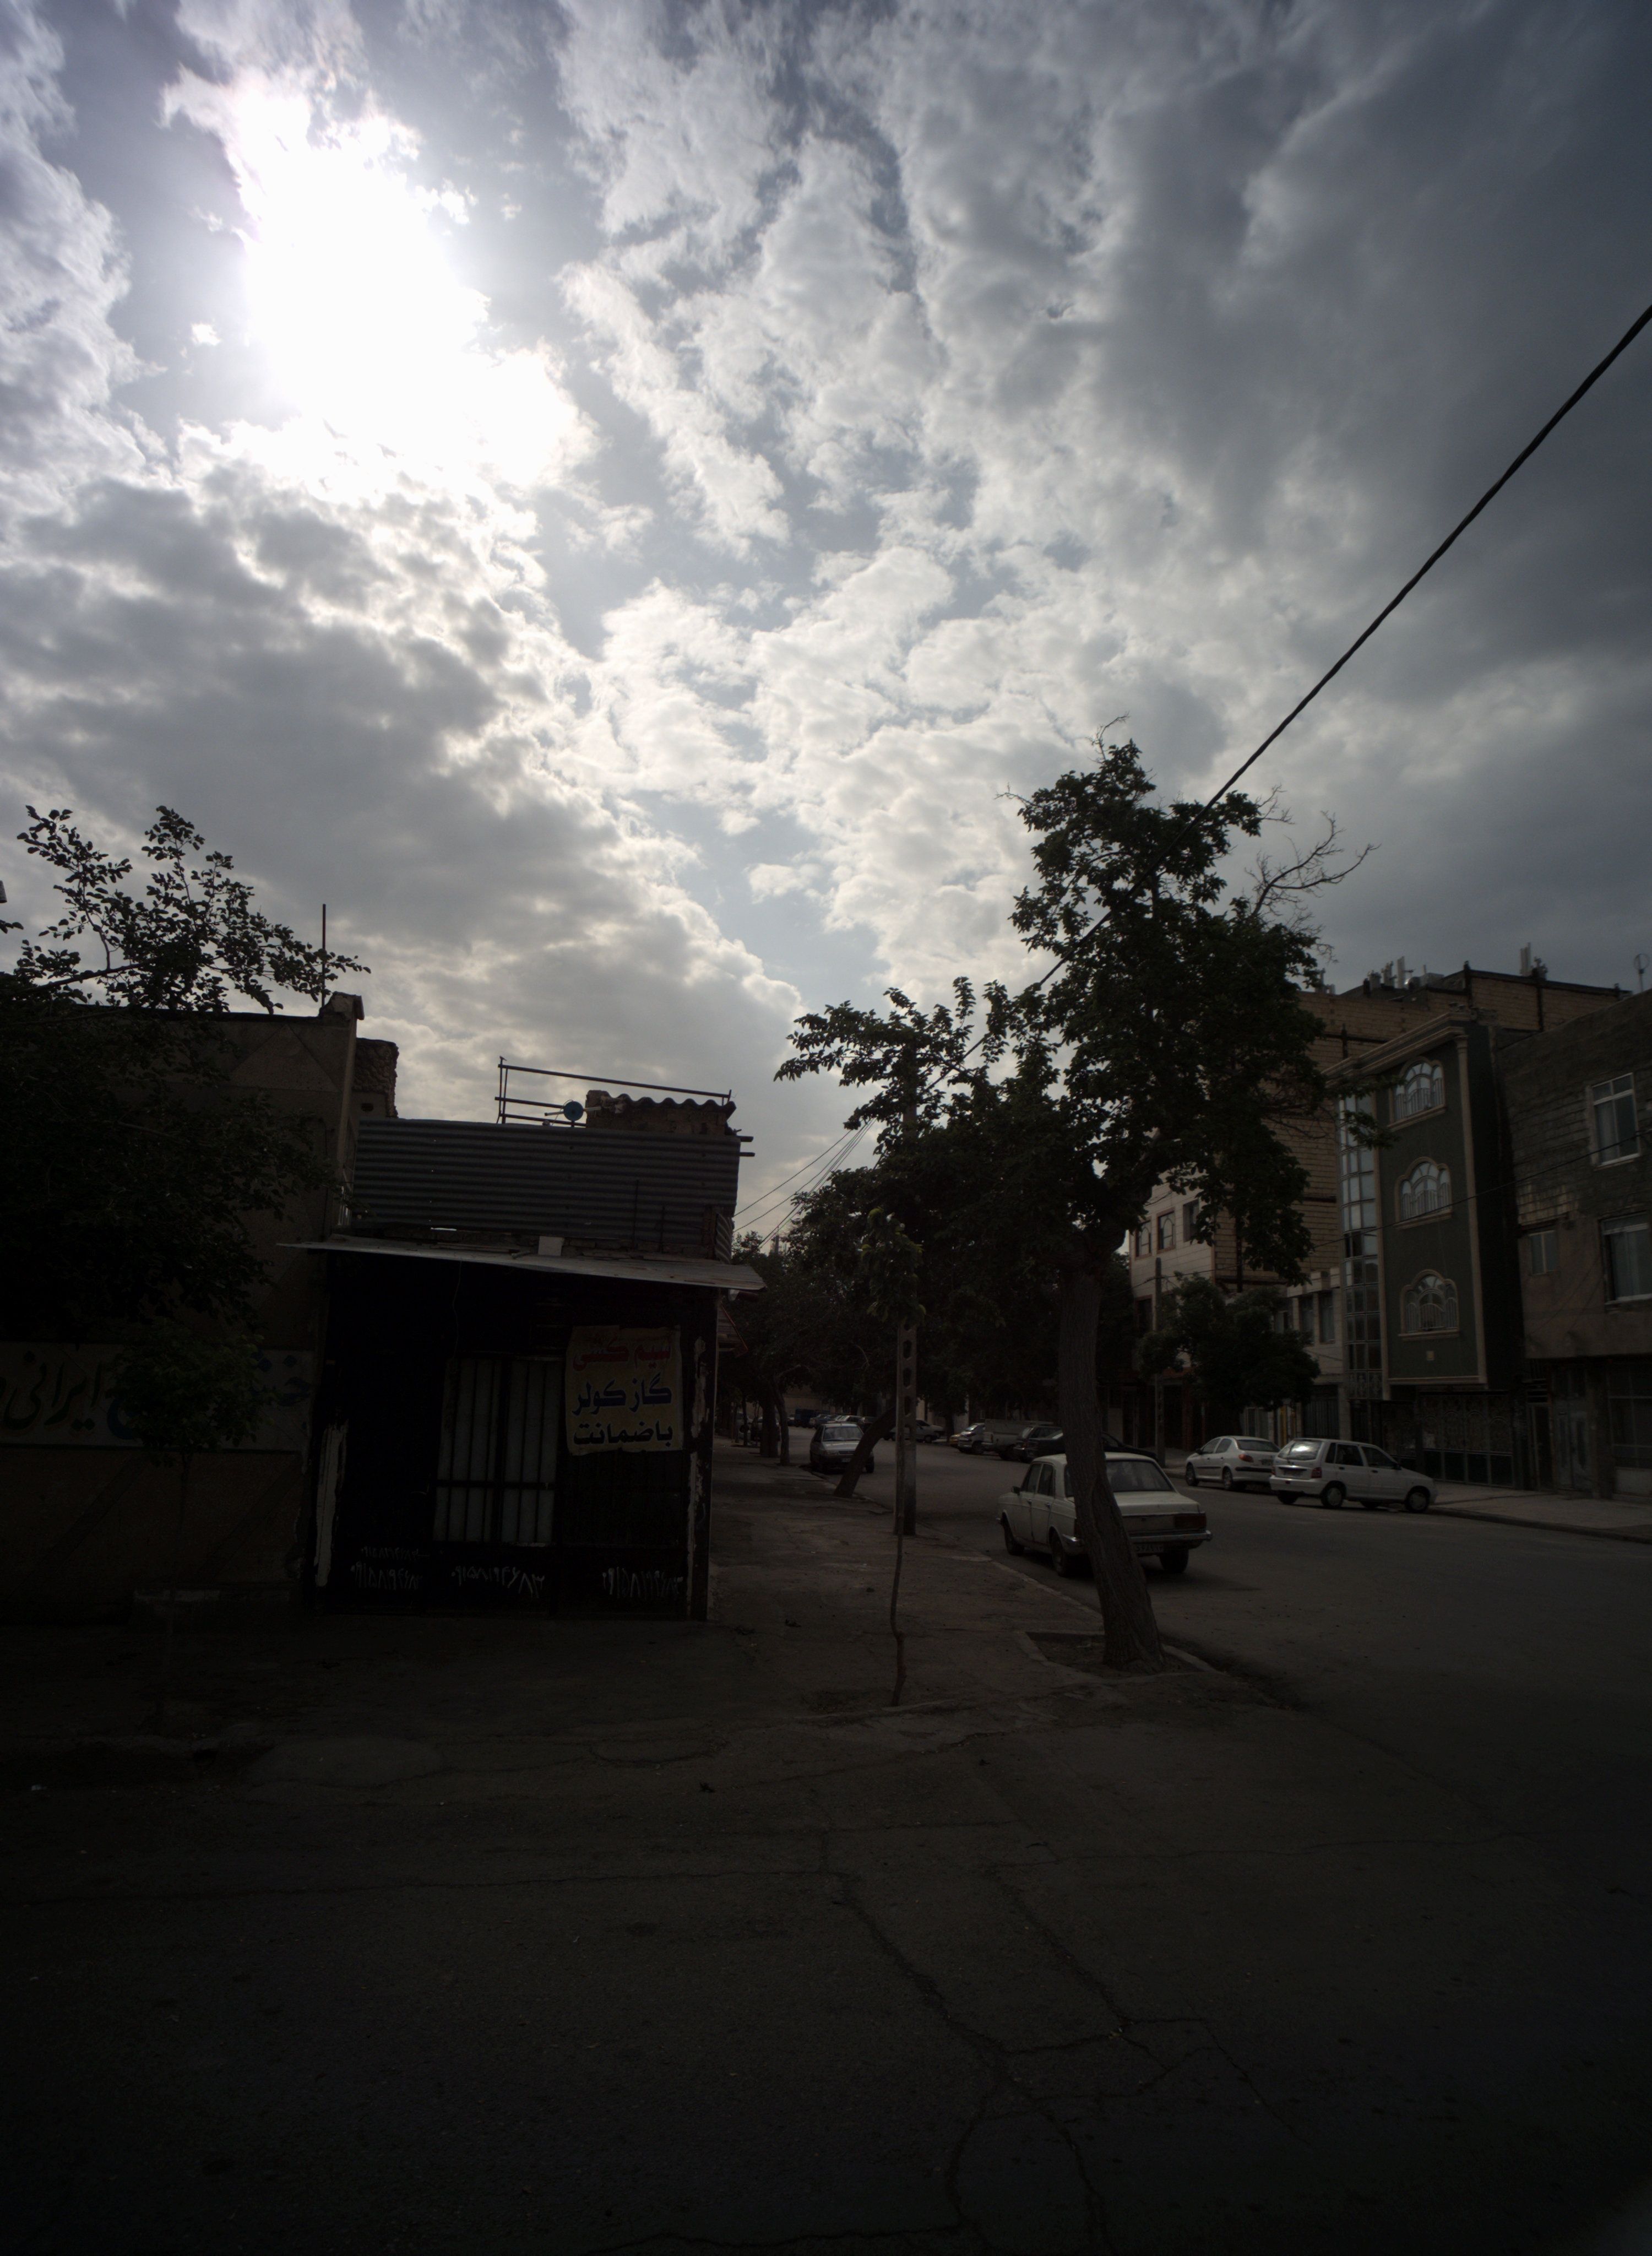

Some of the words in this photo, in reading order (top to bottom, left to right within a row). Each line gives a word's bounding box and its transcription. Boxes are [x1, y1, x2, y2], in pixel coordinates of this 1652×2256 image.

[2, 1351, 103, 1431] ایرانی
[572, 1379, 627, 1416] کولر
[629, 1372, 672, 1413] گاز
